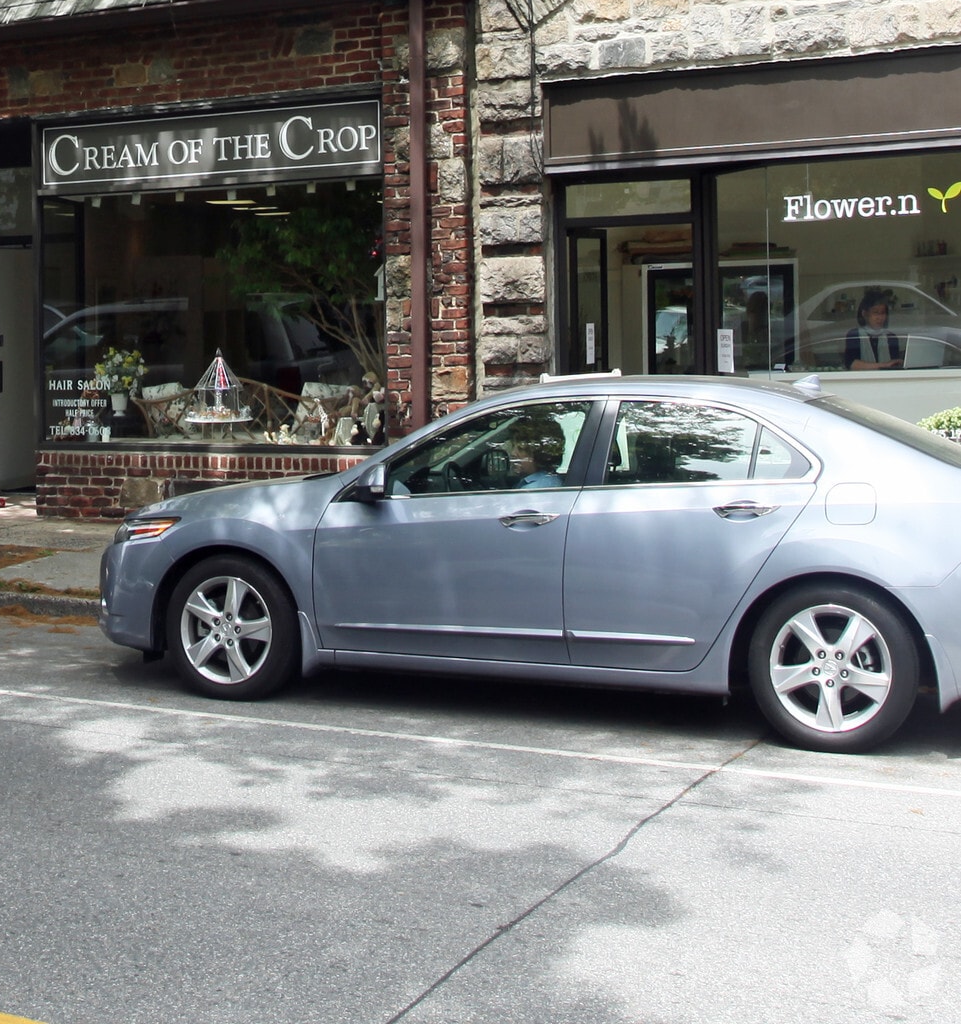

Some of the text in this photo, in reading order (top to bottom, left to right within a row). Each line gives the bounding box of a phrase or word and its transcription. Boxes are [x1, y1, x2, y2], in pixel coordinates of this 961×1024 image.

[48, 115, 377, 176] CREAM OF THE CROP
[783, 194, 921, 221] Flower.n
[49, 380, 110, 390] HAIR SALON
[91, 399, 107, 407] OFFER
